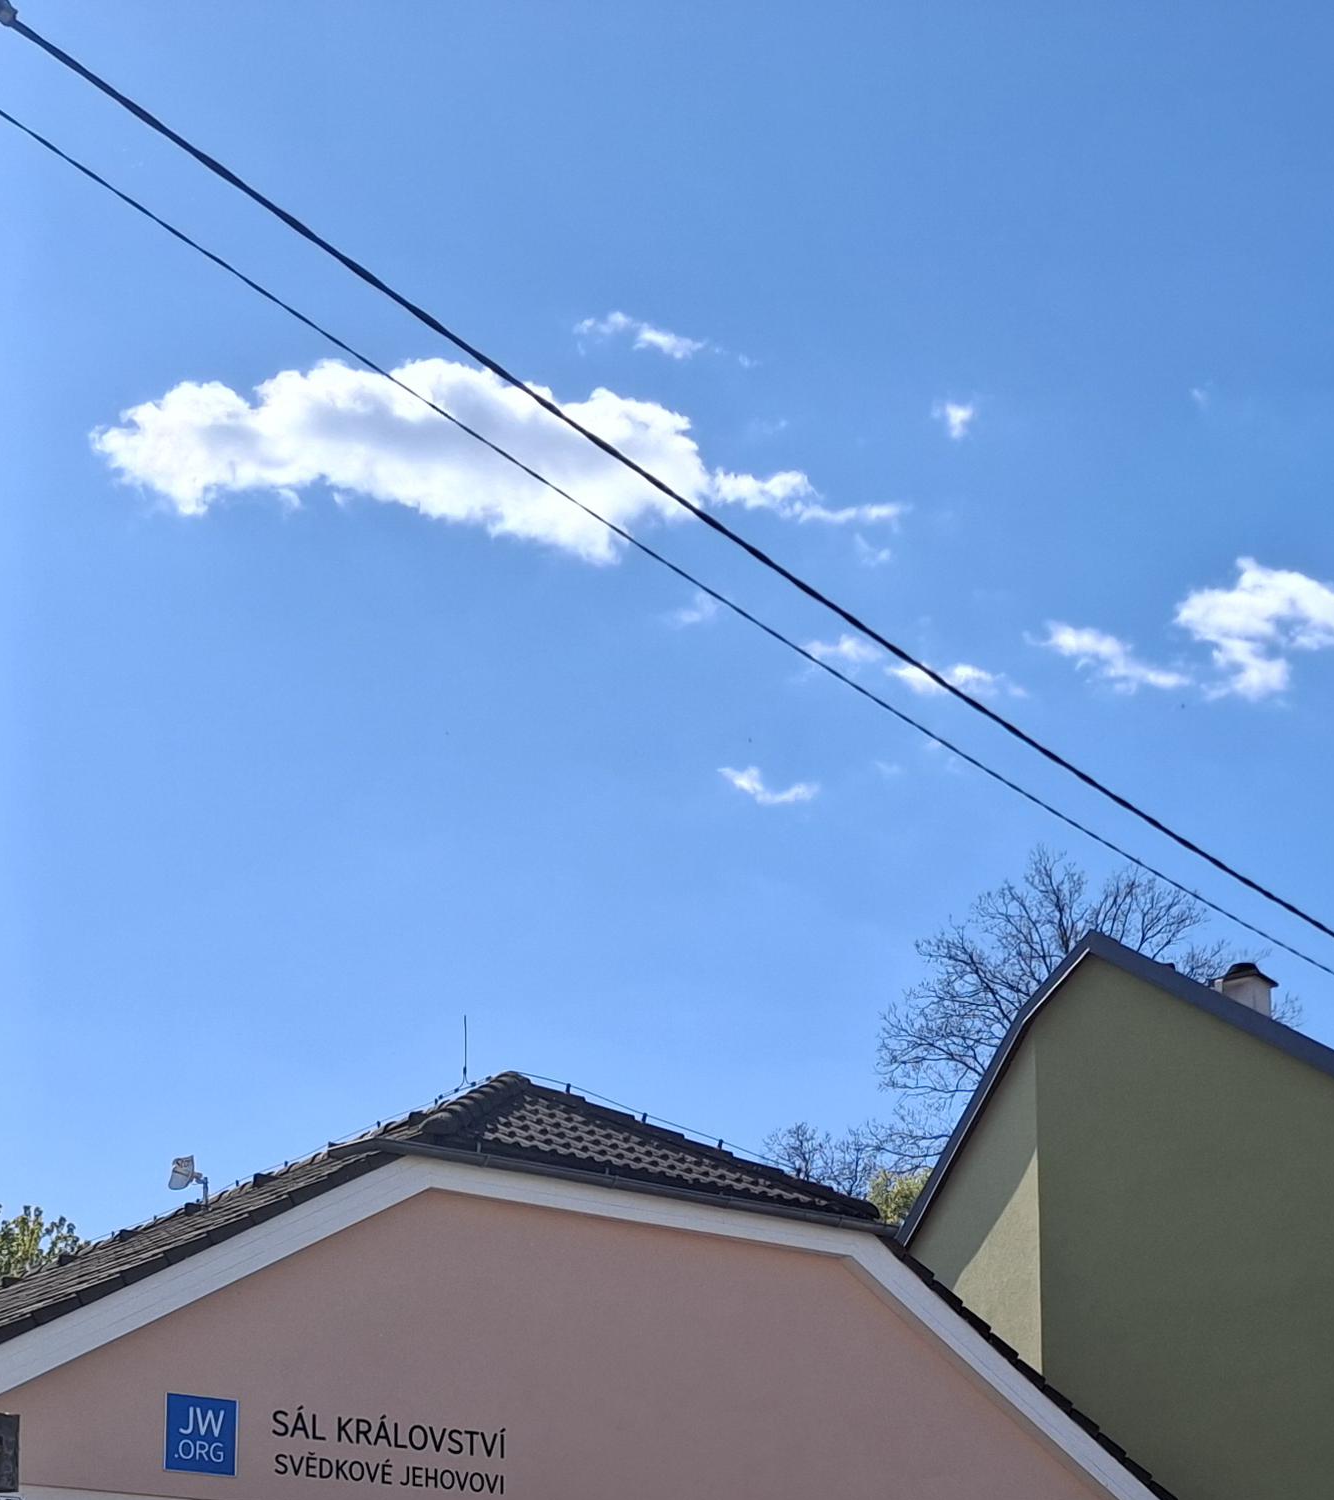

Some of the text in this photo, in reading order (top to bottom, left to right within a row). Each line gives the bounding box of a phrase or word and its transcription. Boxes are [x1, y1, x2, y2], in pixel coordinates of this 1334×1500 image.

[178, 1406, 225, 1438] JW
[271, 1405, 507, 1459] SÁL KRÁLOVSTVÍ
[174, 1439, 224, 1463] .ORG
[274, 1451, 504, 1495] SVĚDKOVÉ JEHOVOVI
